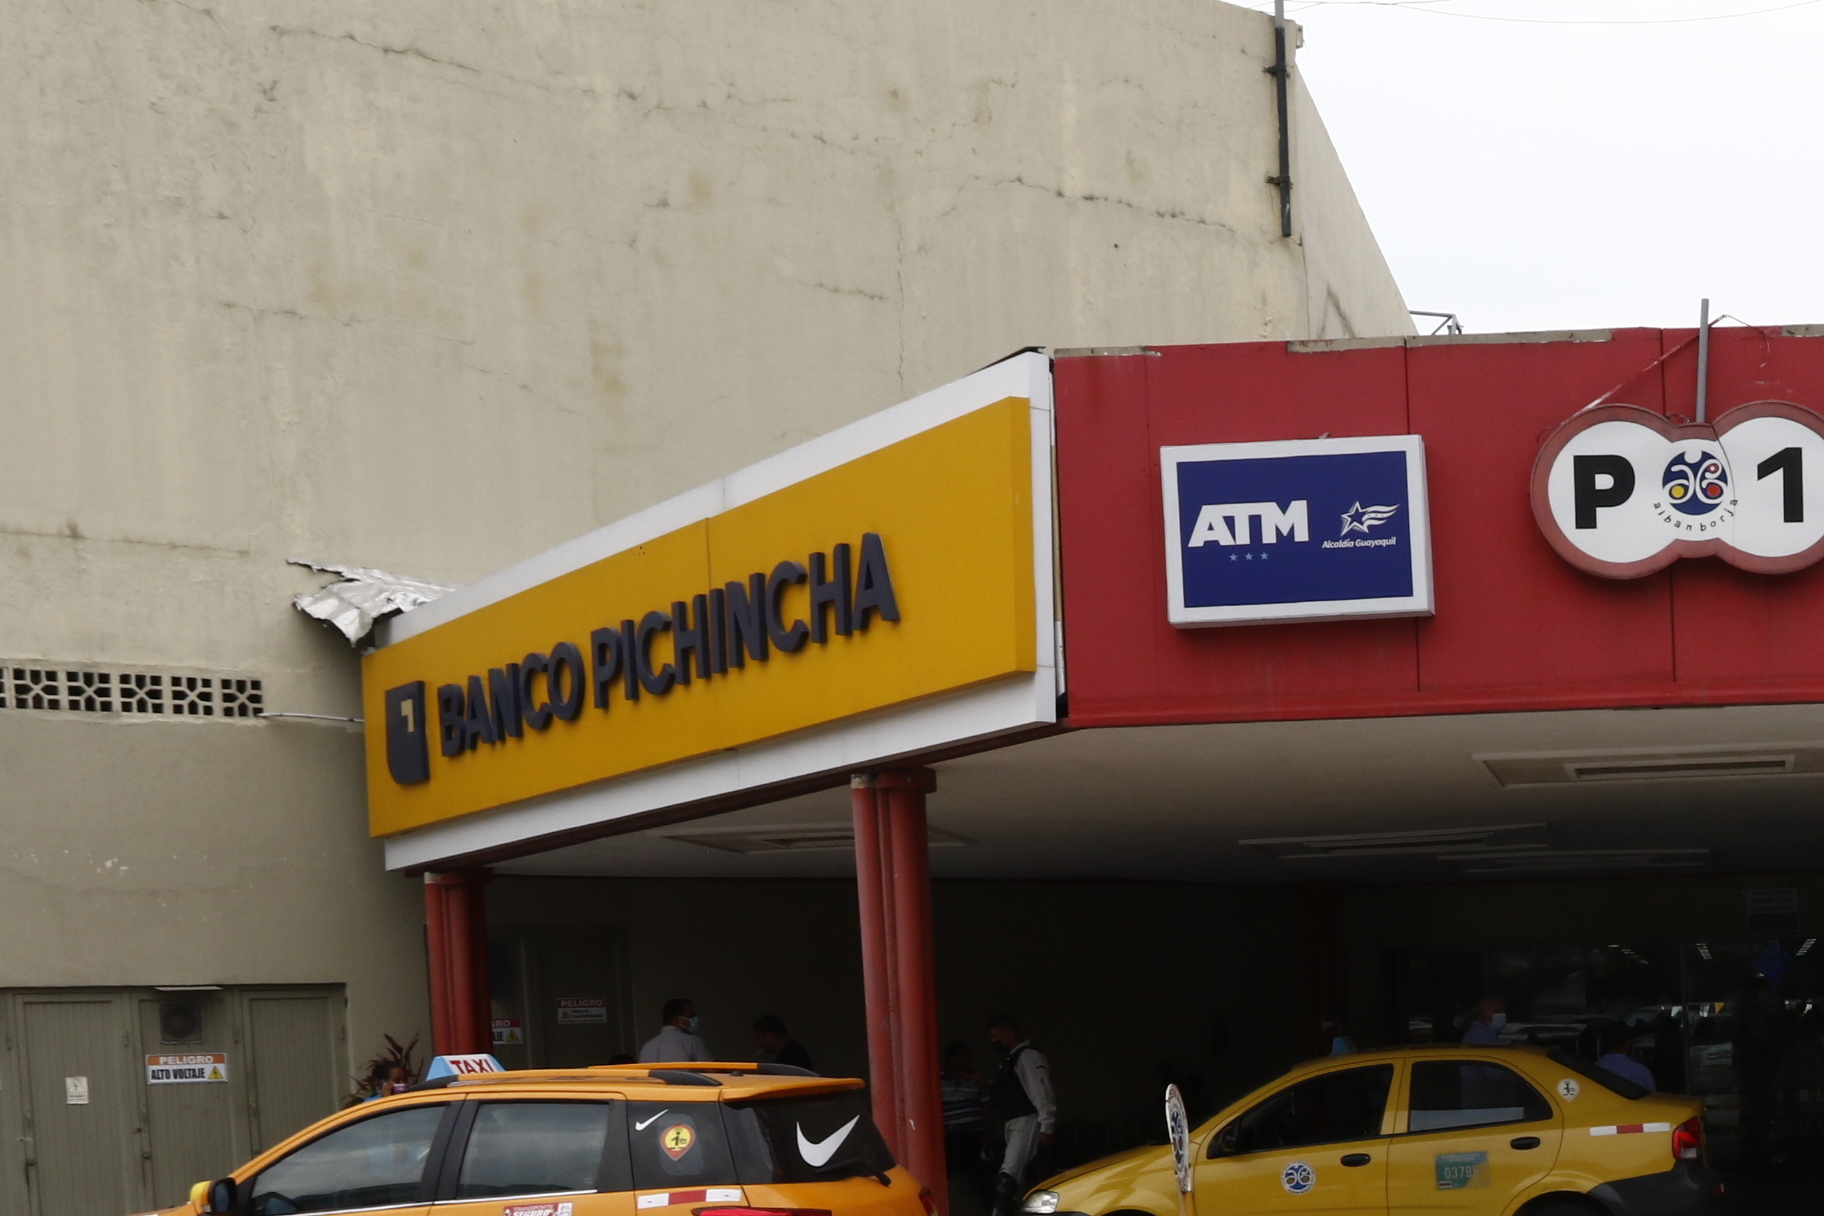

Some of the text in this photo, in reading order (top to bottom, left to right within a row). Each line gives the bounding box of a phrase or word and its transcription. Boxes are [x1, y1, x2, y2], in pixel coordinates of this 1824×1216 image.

[1573, 447, 1804, 529] P 1
[1187, 499, 1309, 547] ATM
[1321, 536, 1397, 549] Alcaldía Guayaquil
[437, 531, 900, 757] BANCO PICHINCHA
[561, 999, 603, 1008] PELIGRO
[159, 1055, 214, 1065] PELIGRO
[450, 1058, 495, 1075] TAXI
[151, 1067, 206, 1081] ALTO VOLTAJE
